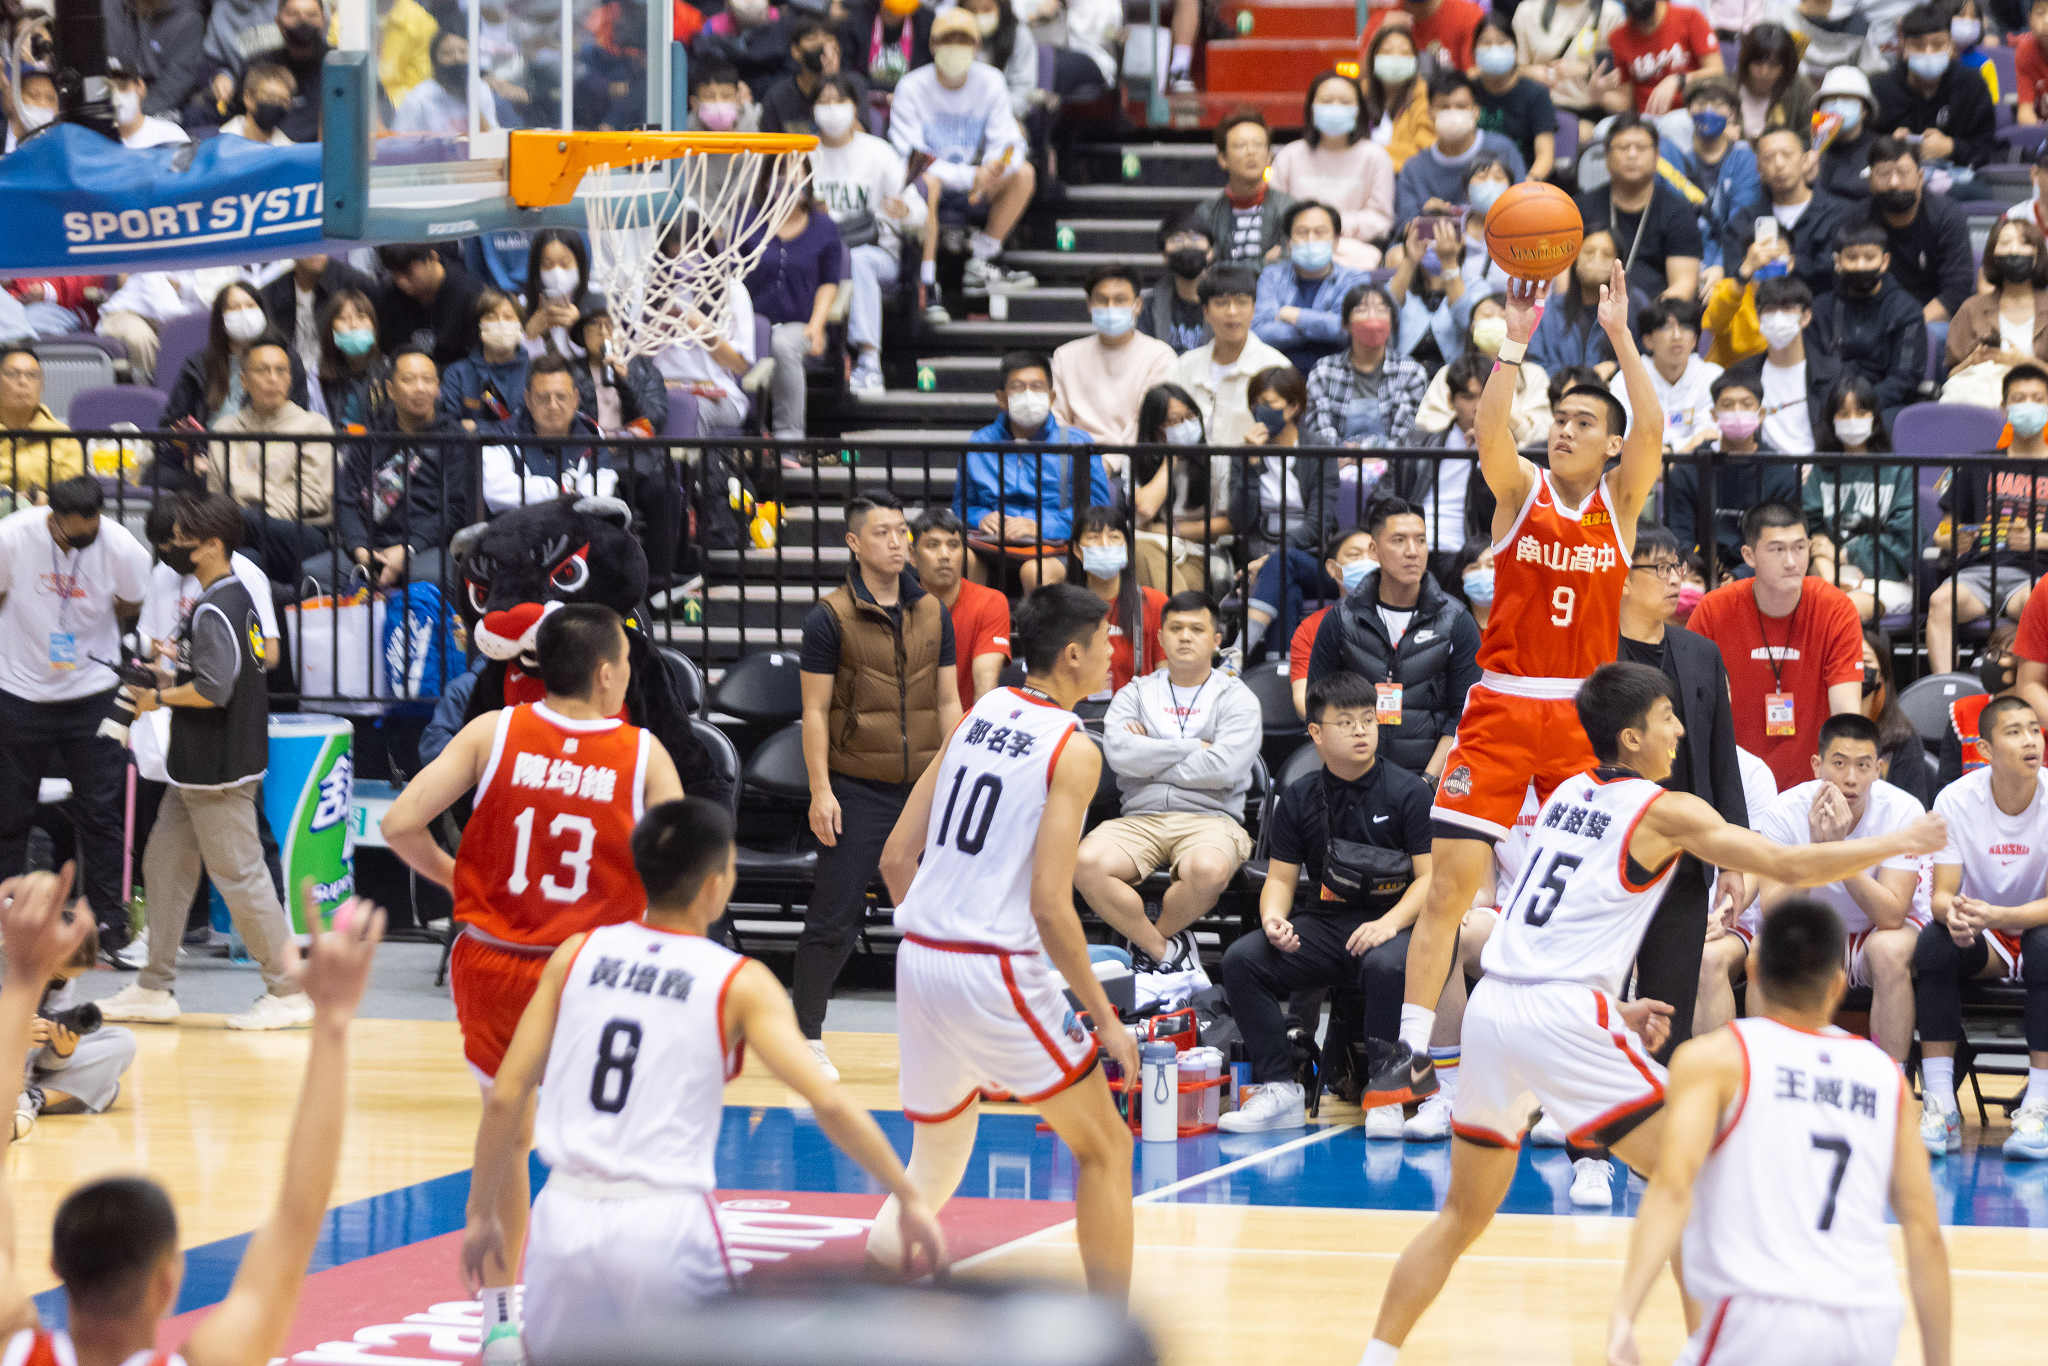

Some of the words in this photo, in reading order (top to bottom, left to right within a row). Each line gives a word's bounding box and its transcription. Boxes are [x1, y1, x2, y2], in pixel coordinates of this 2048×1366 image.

[63, 202, 203, 243] SPORT
[1516, 534, 1616, 574] 南山高中
[1550, 585, 1576, 628] 9
[935, 764, 1004, 857] 10
[507, 806, 599, 903] 13
[1506, 846, 1584, 928] 15
[591, 1017, 643, 1115] 8
[1810, 1133, 1852, 1231] 7
